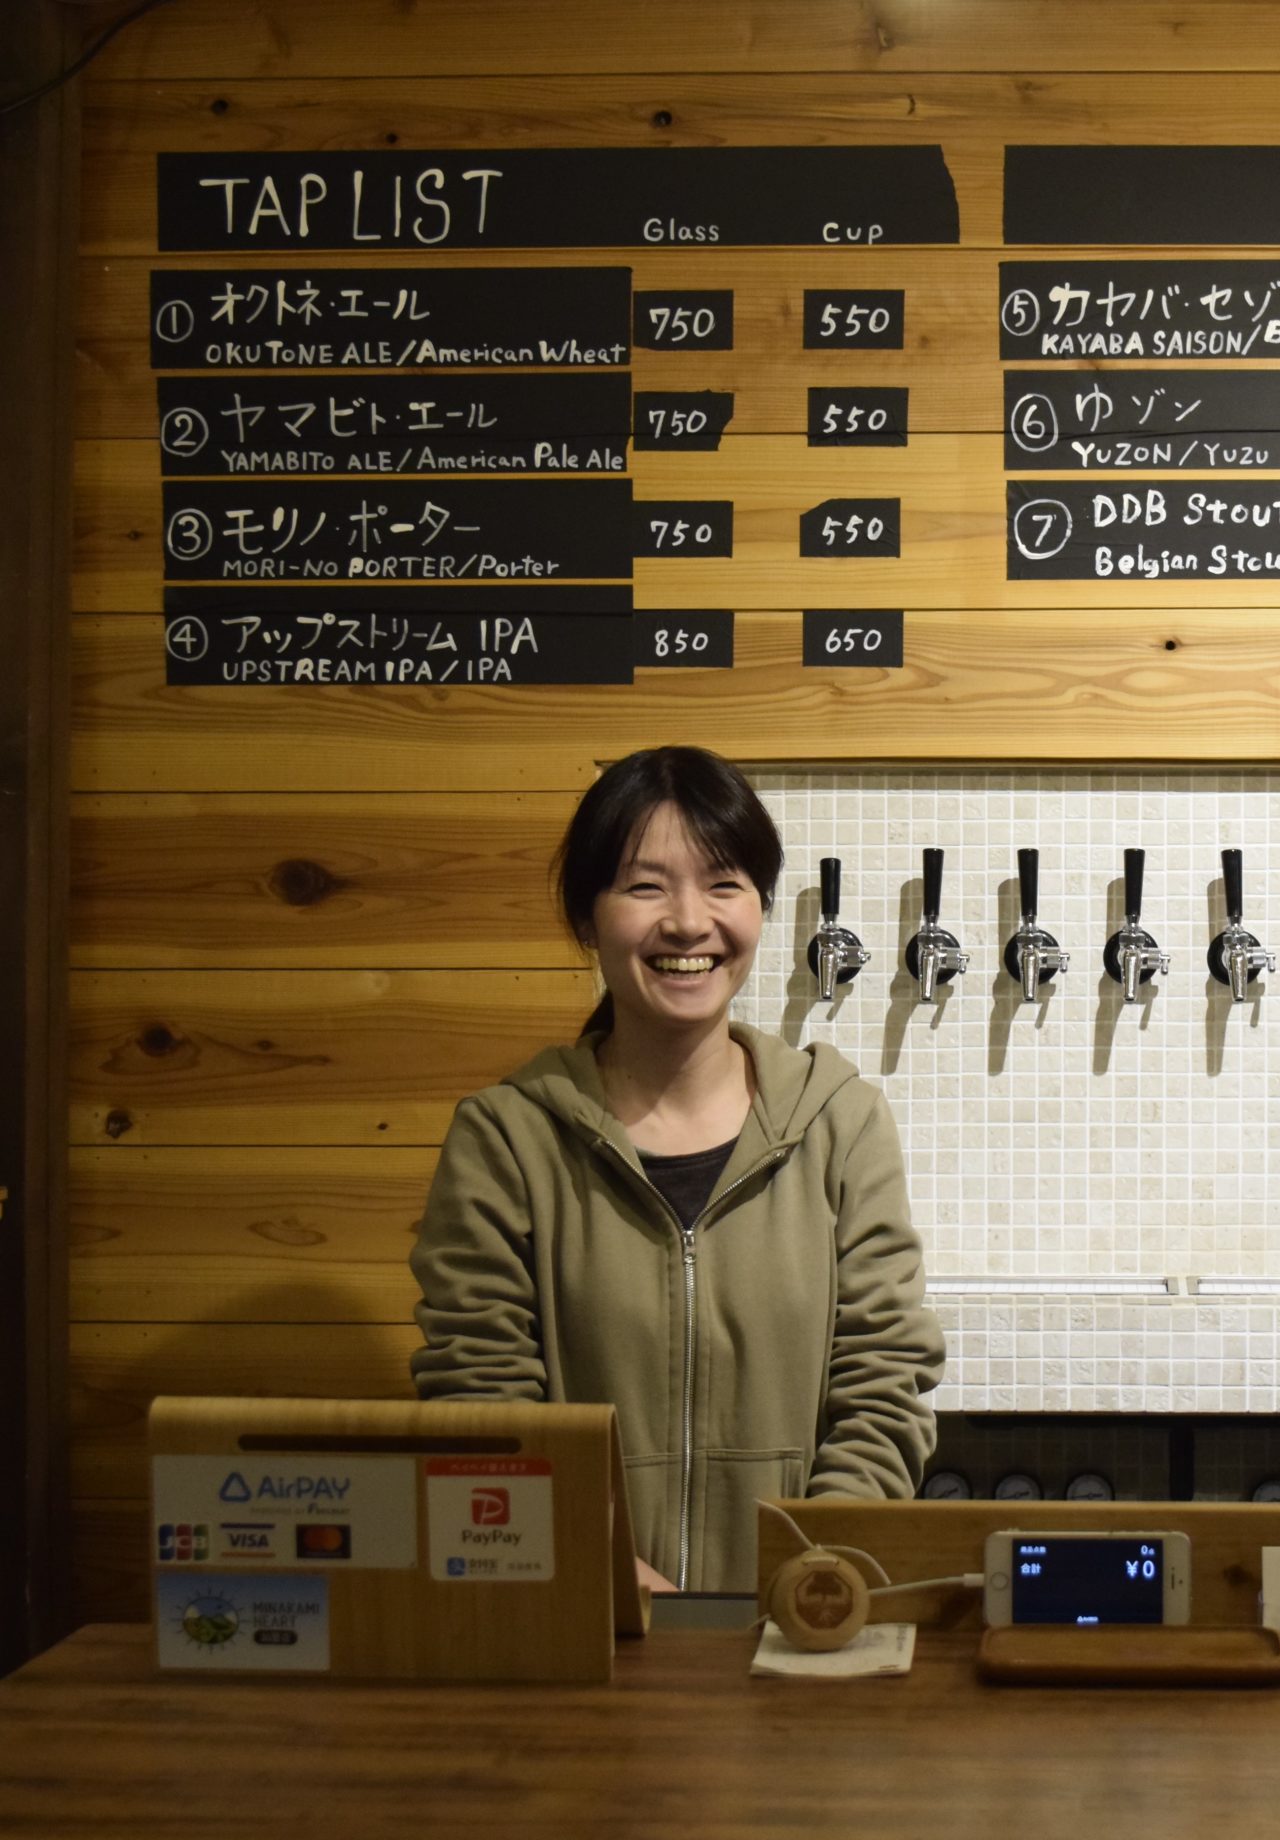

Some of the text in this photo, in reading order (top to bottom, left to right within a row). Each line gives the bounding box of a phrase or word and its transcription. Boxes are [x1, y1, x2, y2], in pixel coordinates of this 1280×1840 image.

[199, 168, 503, 244] TAP LIST
[643, 217, 720, 242] Glass
[822, 221, 884, 246] Cup
[648, 307, 716, 341] 750
[820, 303, 890, 337] 550
[538, 338, 626, 364] Wheat
[1041, 331, 1145, 356] KAYABA
[648, 409, 707, 439] 750
[823, 403, 887, 434] 550
[533, 441, 579, 469] Pale
[585, 447, 623, 471] Ale
[1092, 489, 1167, 528] DDB
[650, 519, 712, 549] 750
[821, 514, 884, 546] 550
[1095, 543, 1198, 579] Belgian
[479, 616, 539, 655] IPA
[654, 628, 709, 657] 850
[825, 628, 882, 654] 650
[257, 1476, 351, 1500] AirPAY
[227, 1533, 270, 1548] VISA
[461, 1529, 523, 1547] PayPay
[253, 1615, 297, 1628] HEART
